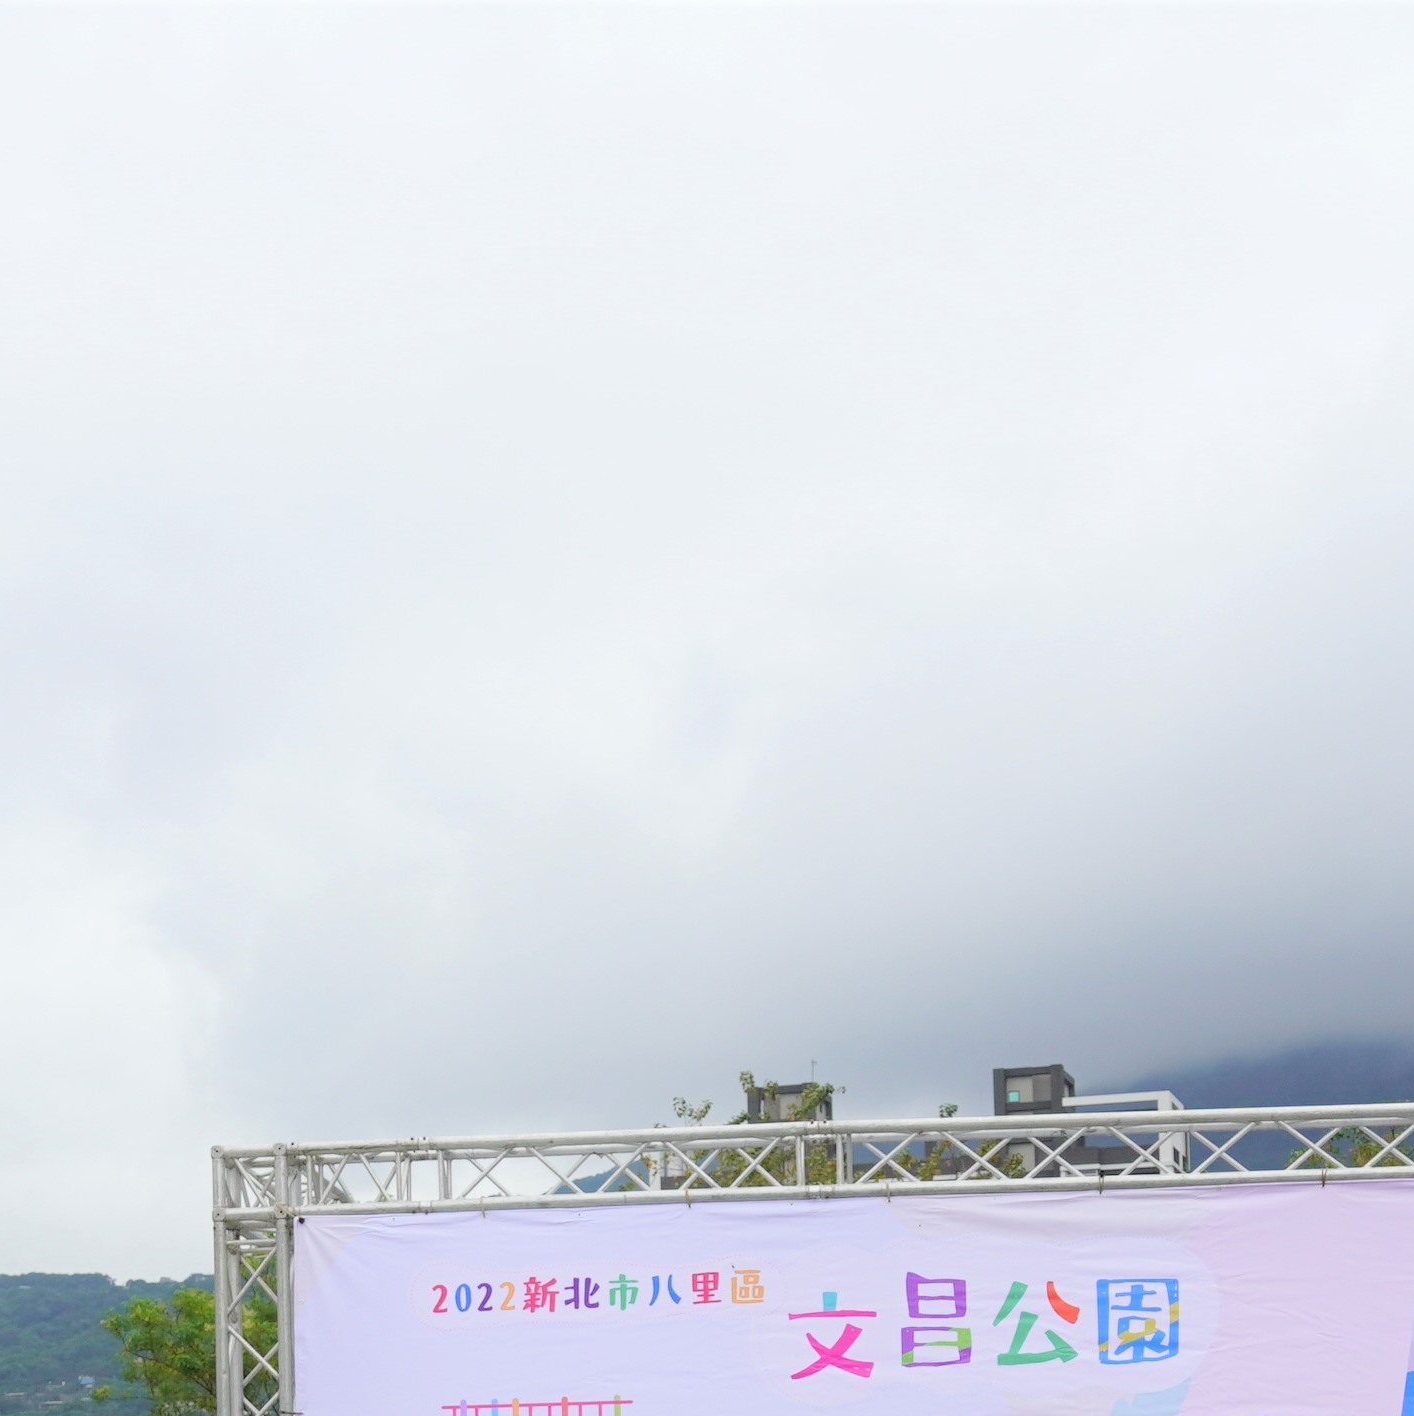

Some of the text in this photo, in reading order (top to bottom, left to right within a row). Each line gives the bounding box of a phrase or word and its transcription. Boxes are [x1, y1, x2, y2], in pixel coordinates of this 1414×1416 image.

[432, 1269, 764, 1313] 2022新北市八里區
[788, 1271, 1180, 1380] 文昌公園
